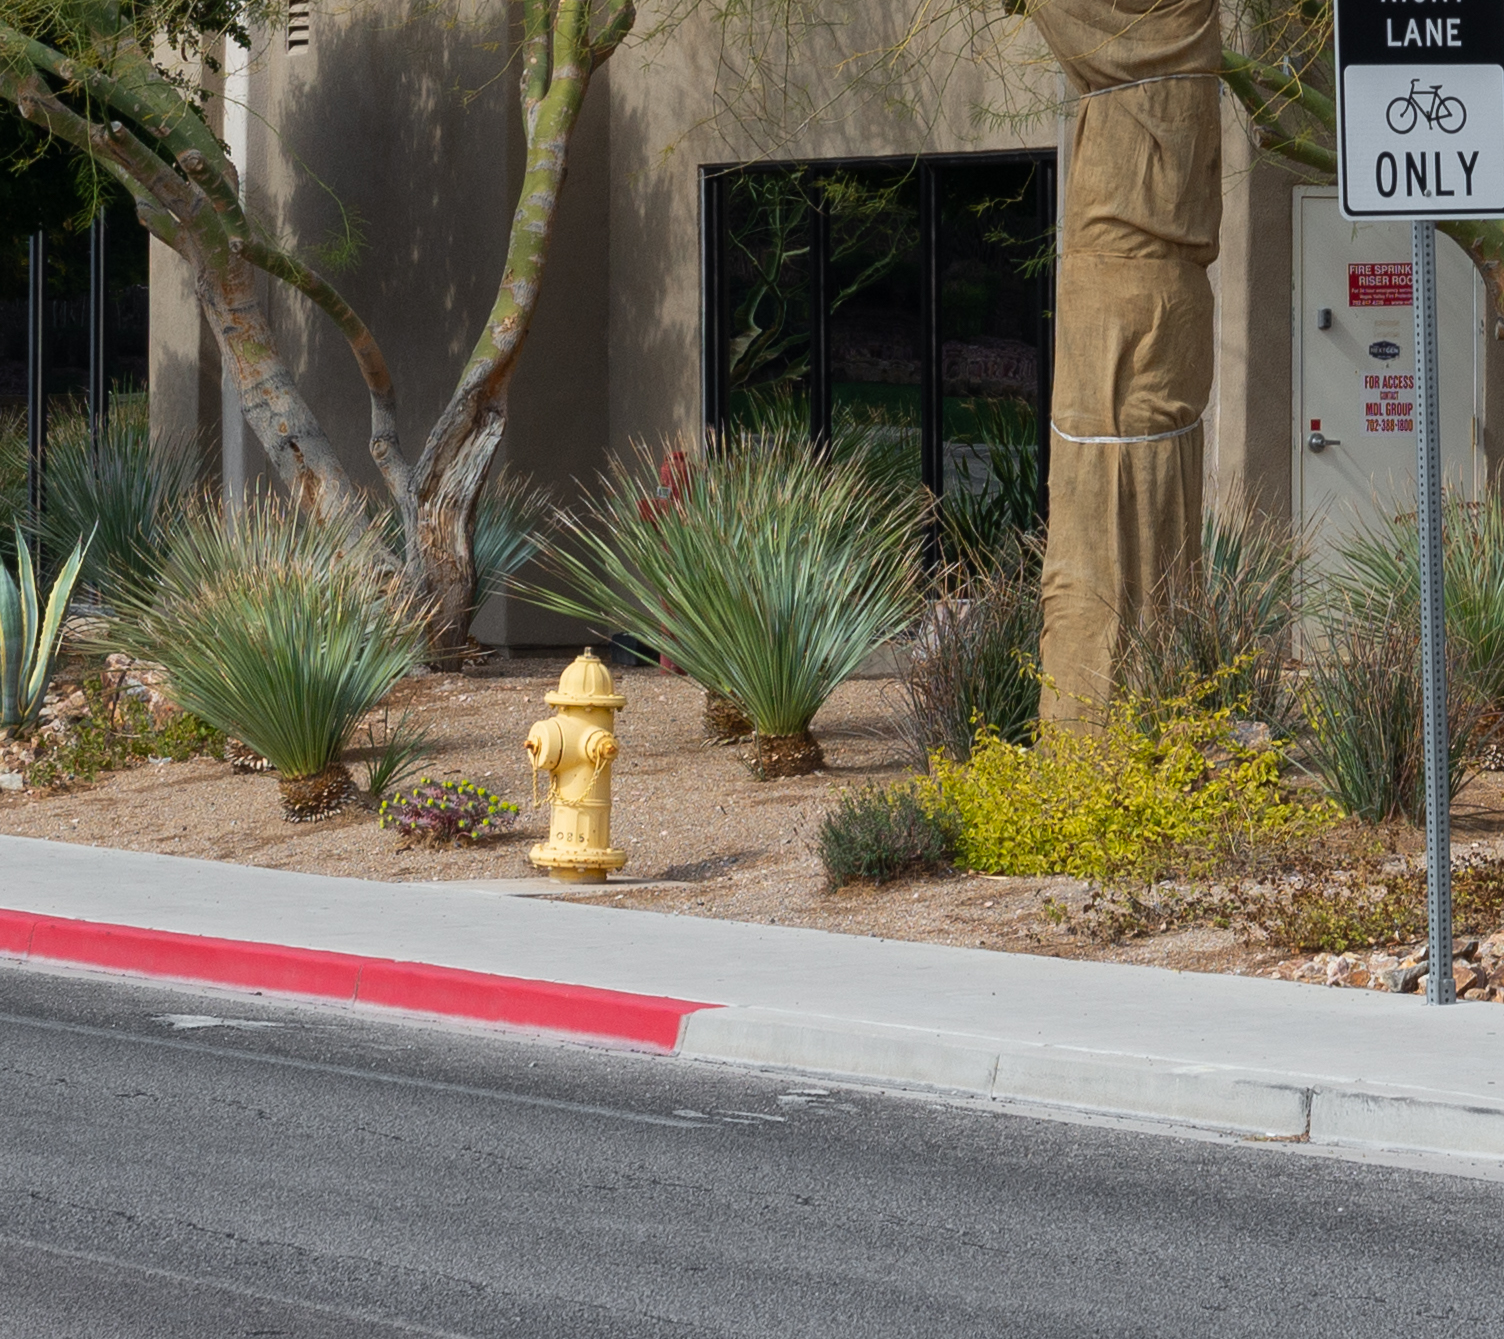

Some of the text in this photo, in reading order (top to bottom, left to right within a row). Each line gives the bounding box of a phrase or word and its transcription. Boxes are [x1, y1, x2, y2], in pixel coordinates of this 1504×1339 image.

[1386, 18, 1462, 48] LANE
[1375, 150, 1480, 198] ONLY
[1349, 264, 1412, 275] FIRE SPRINK
[1358, 275, 1413, 286] RISER ROO
[1364, 375, 1414, 389] FOR ACCESS
[1365, 402, 1413, 416] MDL GROUP
[1366, 418, 1414, 432] 702-388-1800
